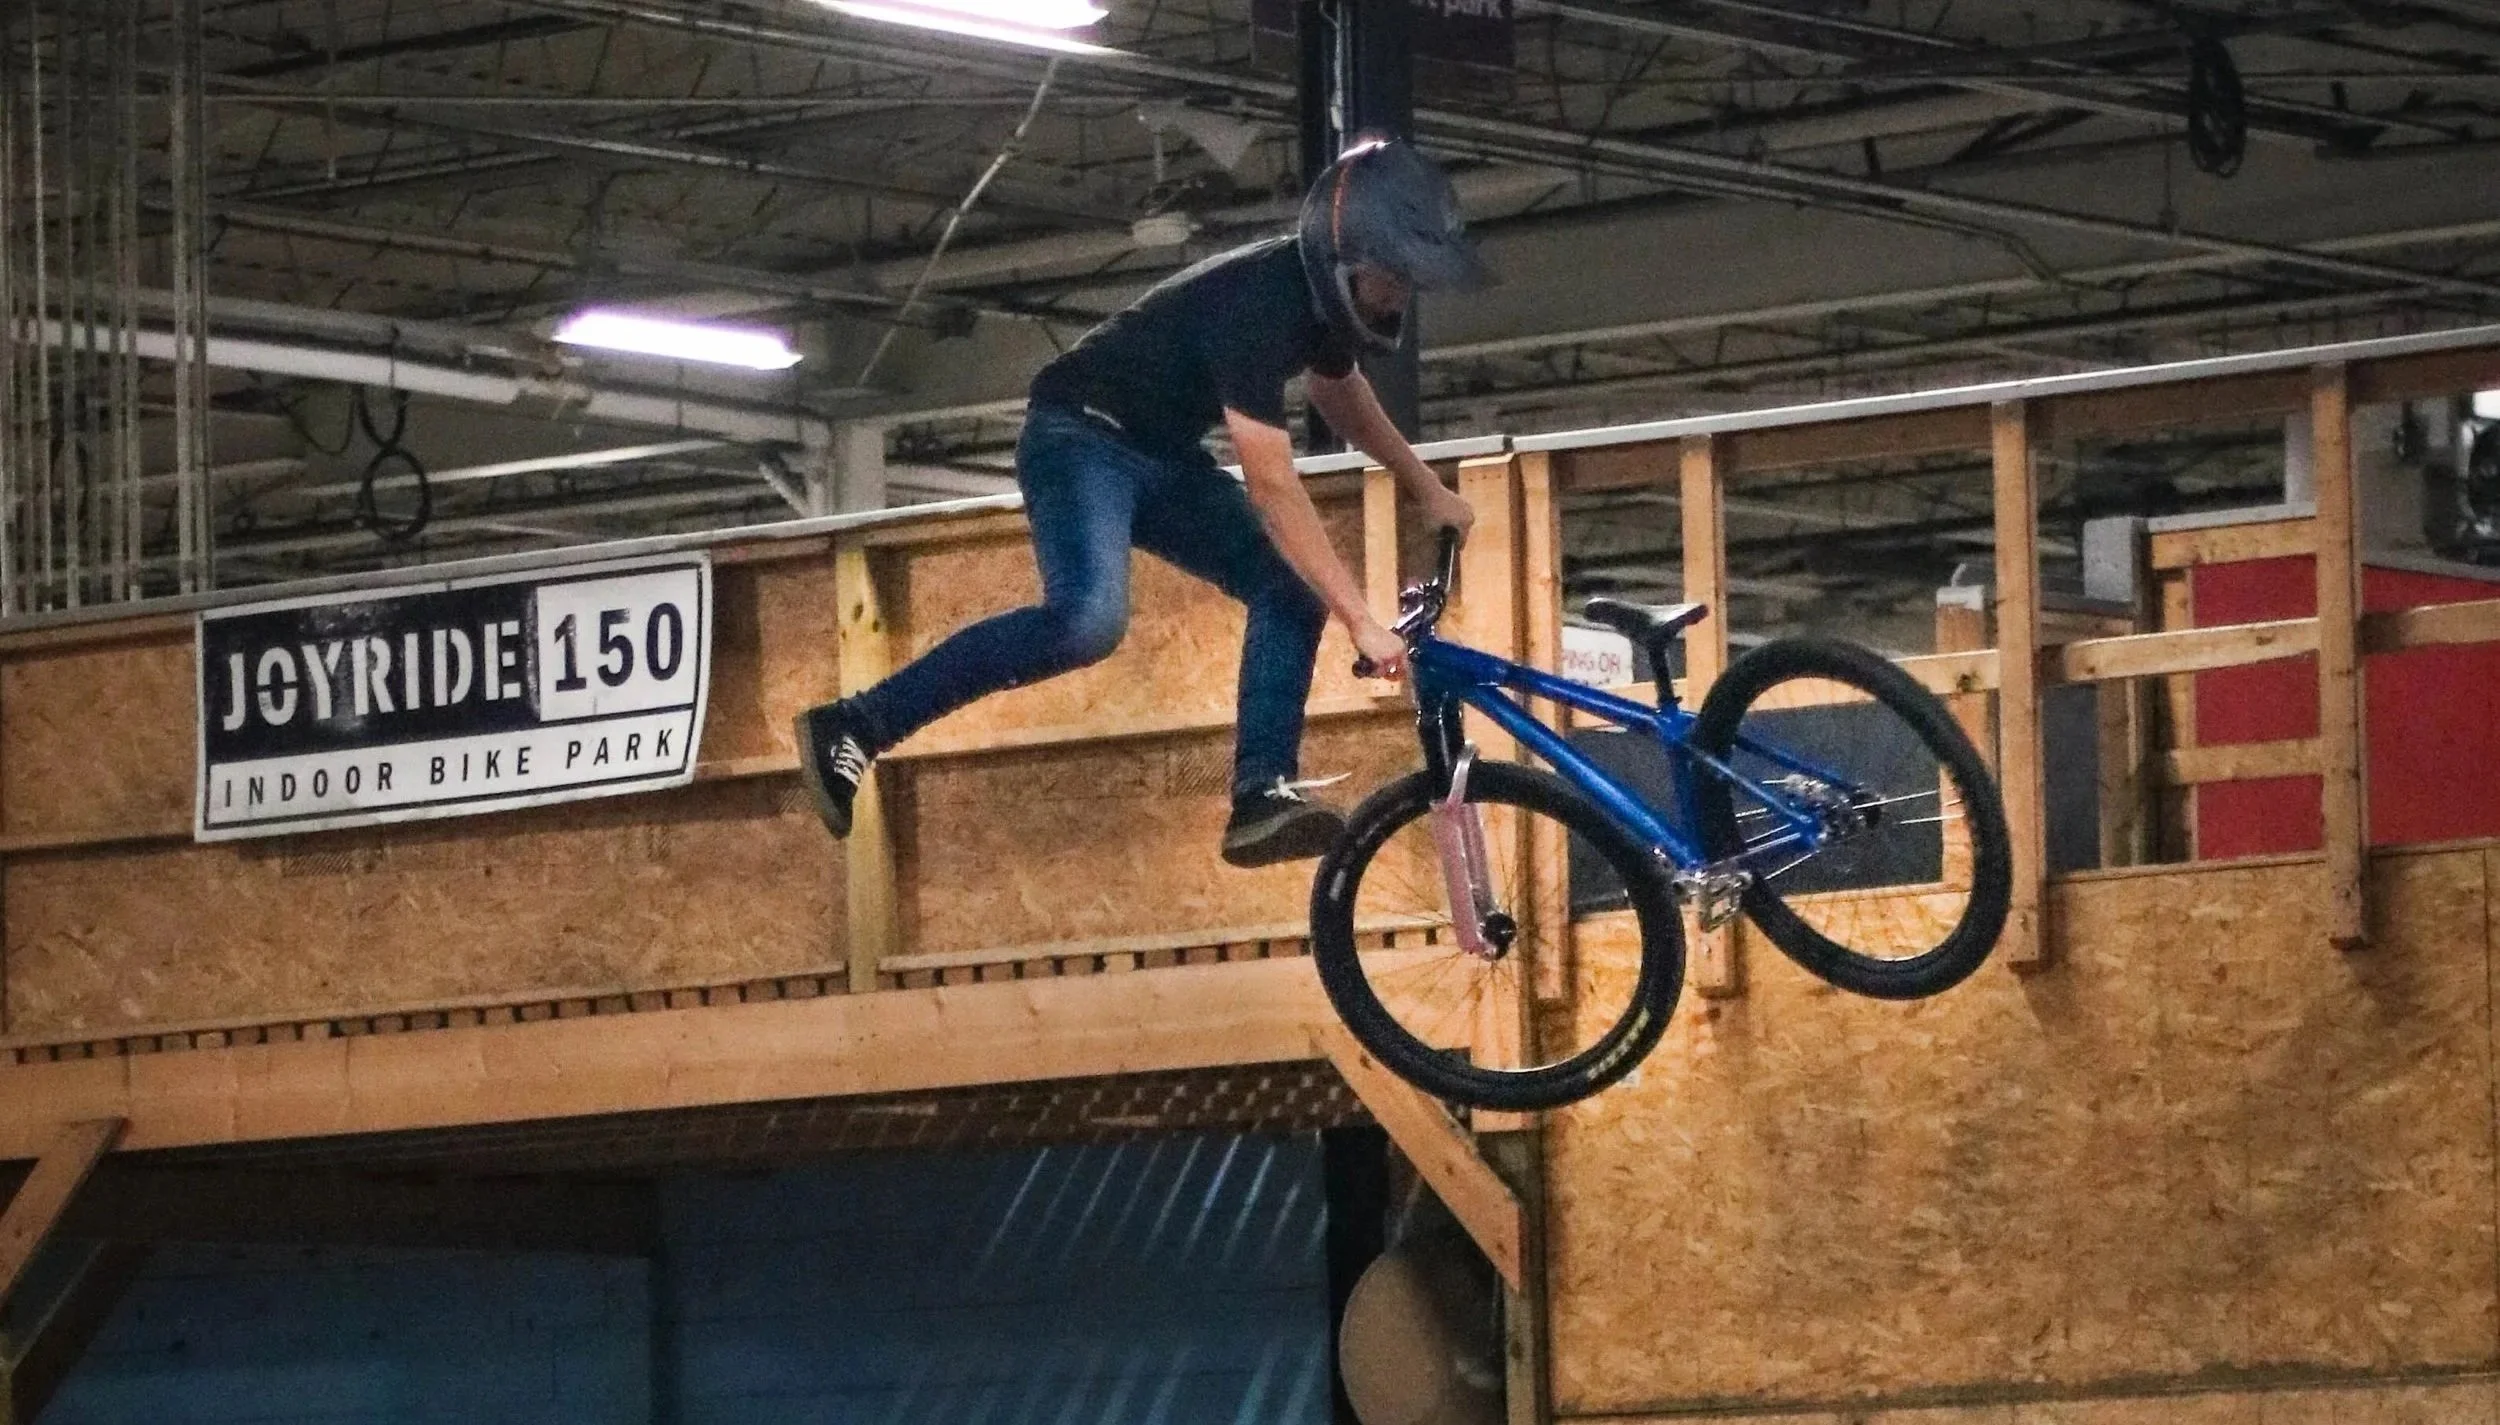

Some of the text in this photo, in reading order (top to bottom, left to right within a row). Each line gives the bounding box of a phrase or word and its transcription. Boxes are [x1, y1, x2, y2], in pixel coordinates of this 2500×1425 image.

[223, 601, 684, 732] JOYRIDE 150
[224, 729, 674, 808] INDOOR BIKE PARK
